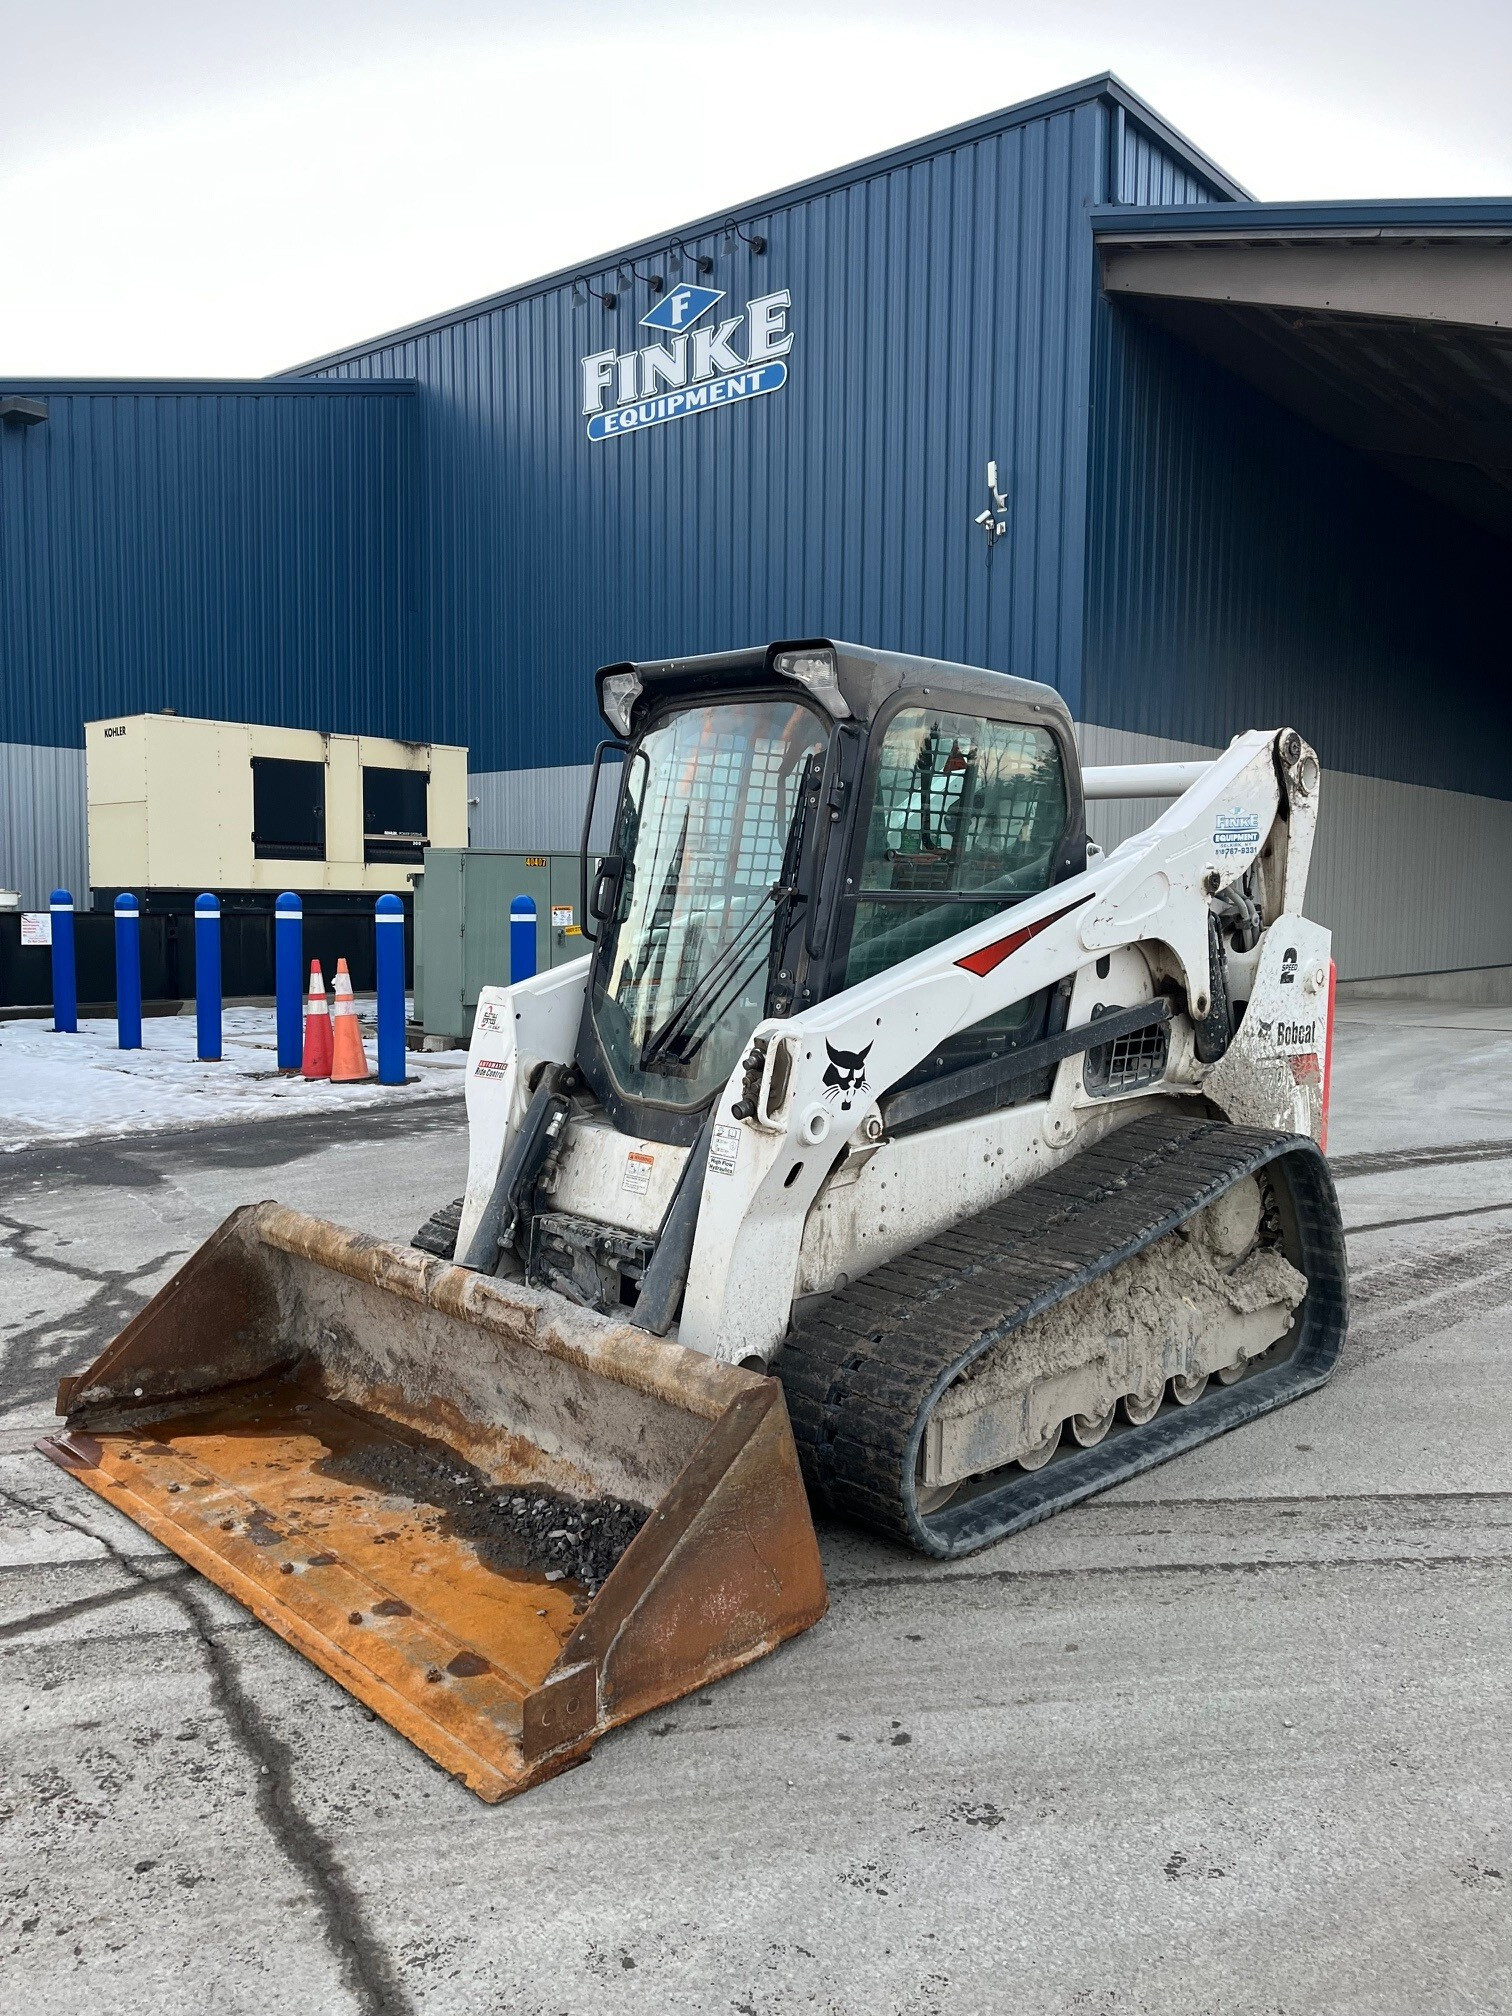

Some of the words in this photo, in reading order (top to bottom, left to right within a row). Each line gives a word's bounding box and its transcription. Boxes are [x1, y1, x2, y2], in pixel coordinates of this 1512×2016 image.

[671, 291, 691, 326] F
[581, 289, 794, 415] FINKE
[604, 370, 766, 433] EQUIPMENT
[104, 725, 127, 738] KOHLER
[1215, 814, 1259, 828] FINKE
[1214, 834, 1258, 842] EQUIPMENT
[1281, 963, 1299, 972] SPEED
[1277, 1021, 1316, 1046] Bobcat
[479, 1061, 508, 1070] AUTOMATIC
[475, 1067, 487, 1077] Ride
[486, 1068, 506, 1079] Control
[722, 1159, 734, 1167] Flow
